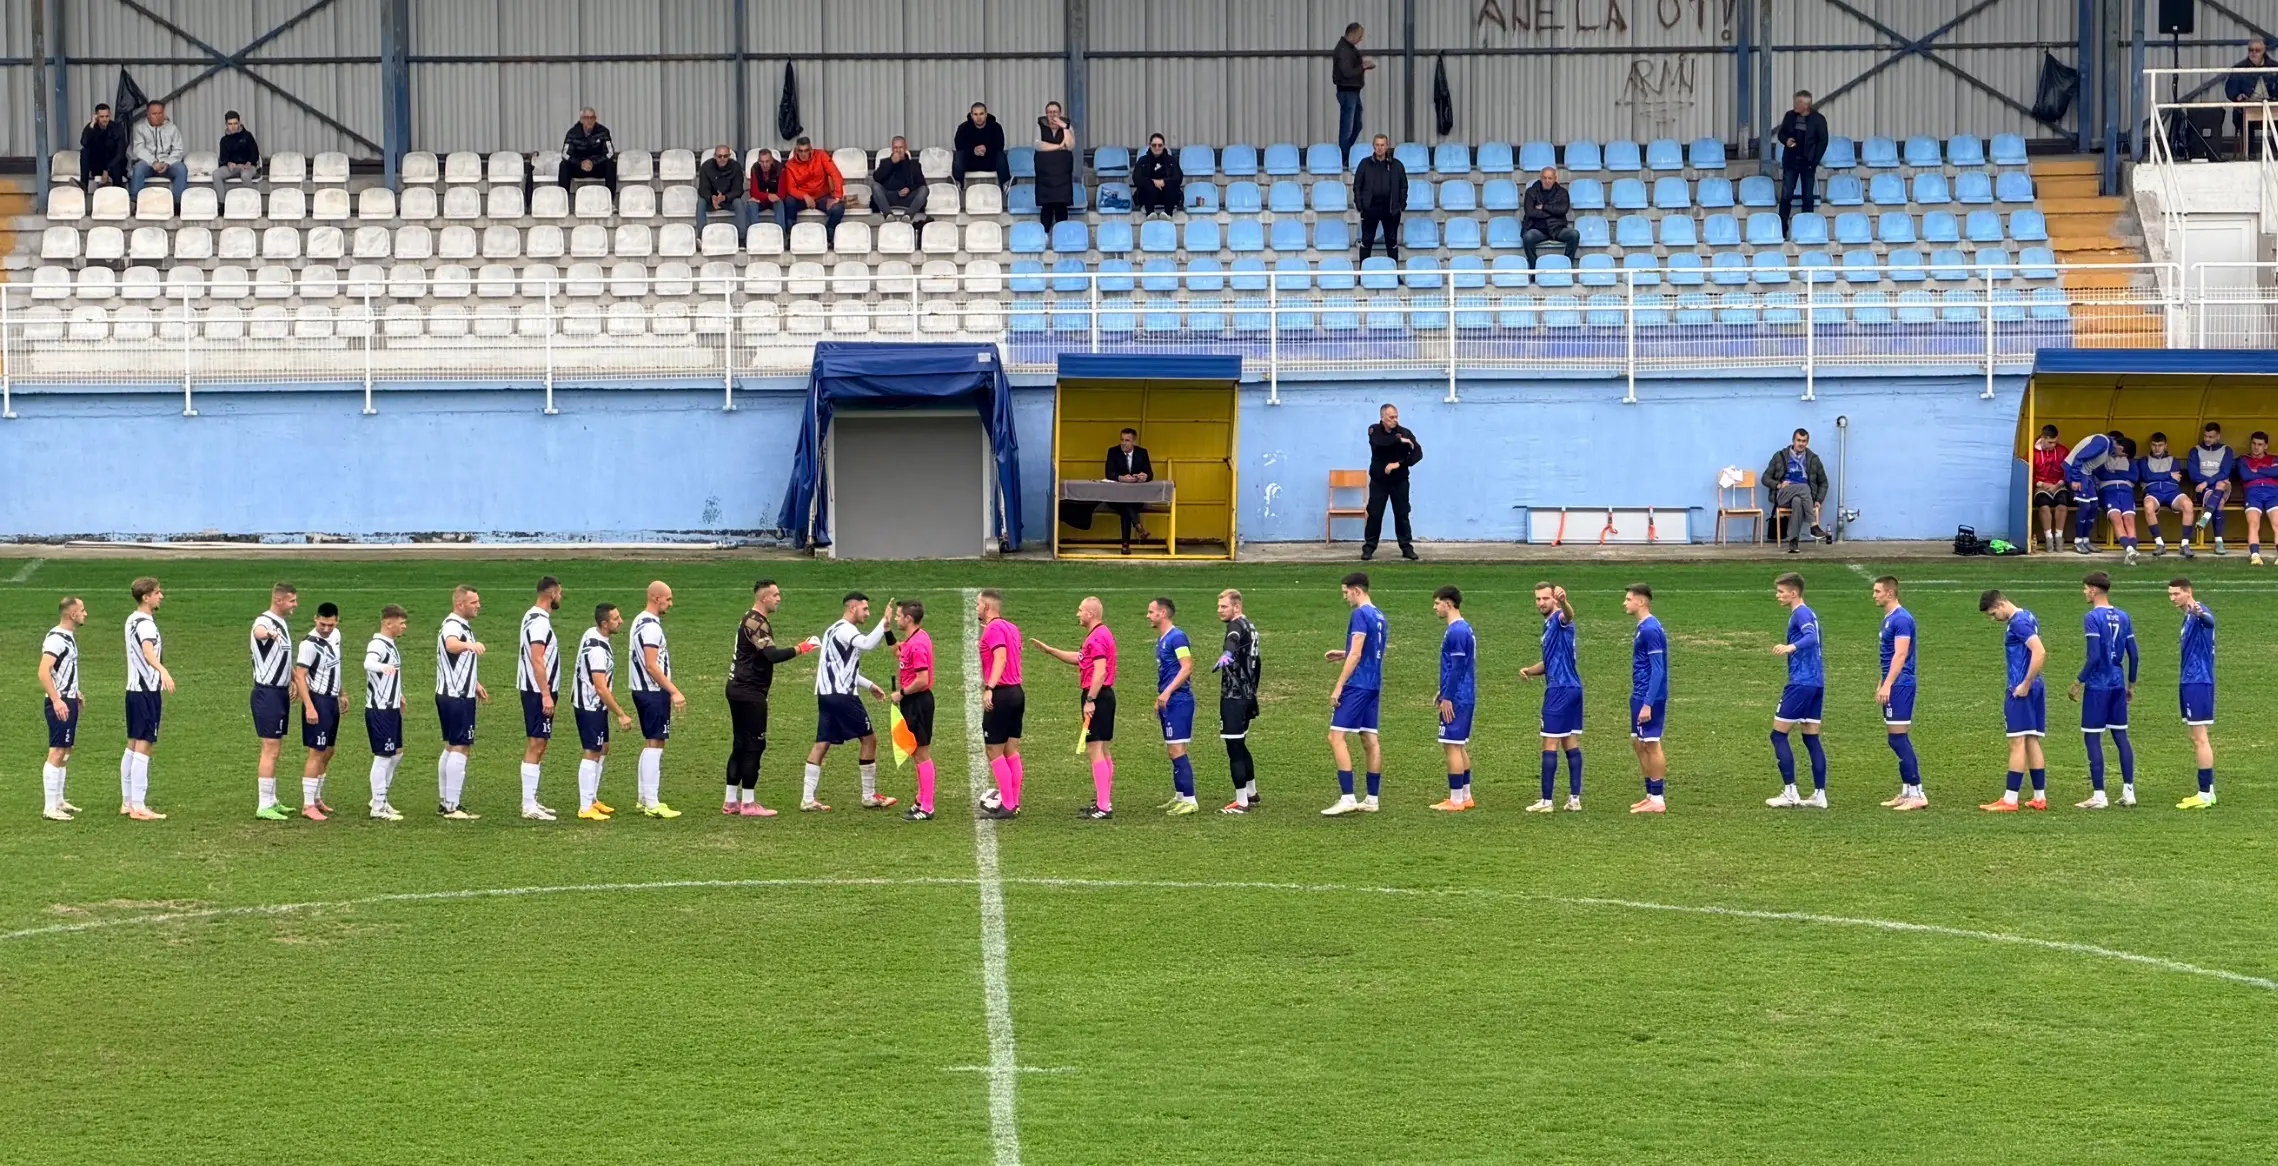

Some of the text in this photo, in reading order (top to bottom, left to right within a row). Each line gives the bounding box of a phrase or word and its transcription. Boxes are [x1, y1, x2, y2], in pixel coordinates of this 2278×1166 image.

[2107, 622, 2120, 648] 17
[316, 735, 327, 746] 10
[384, 742, 395, 752] 20
